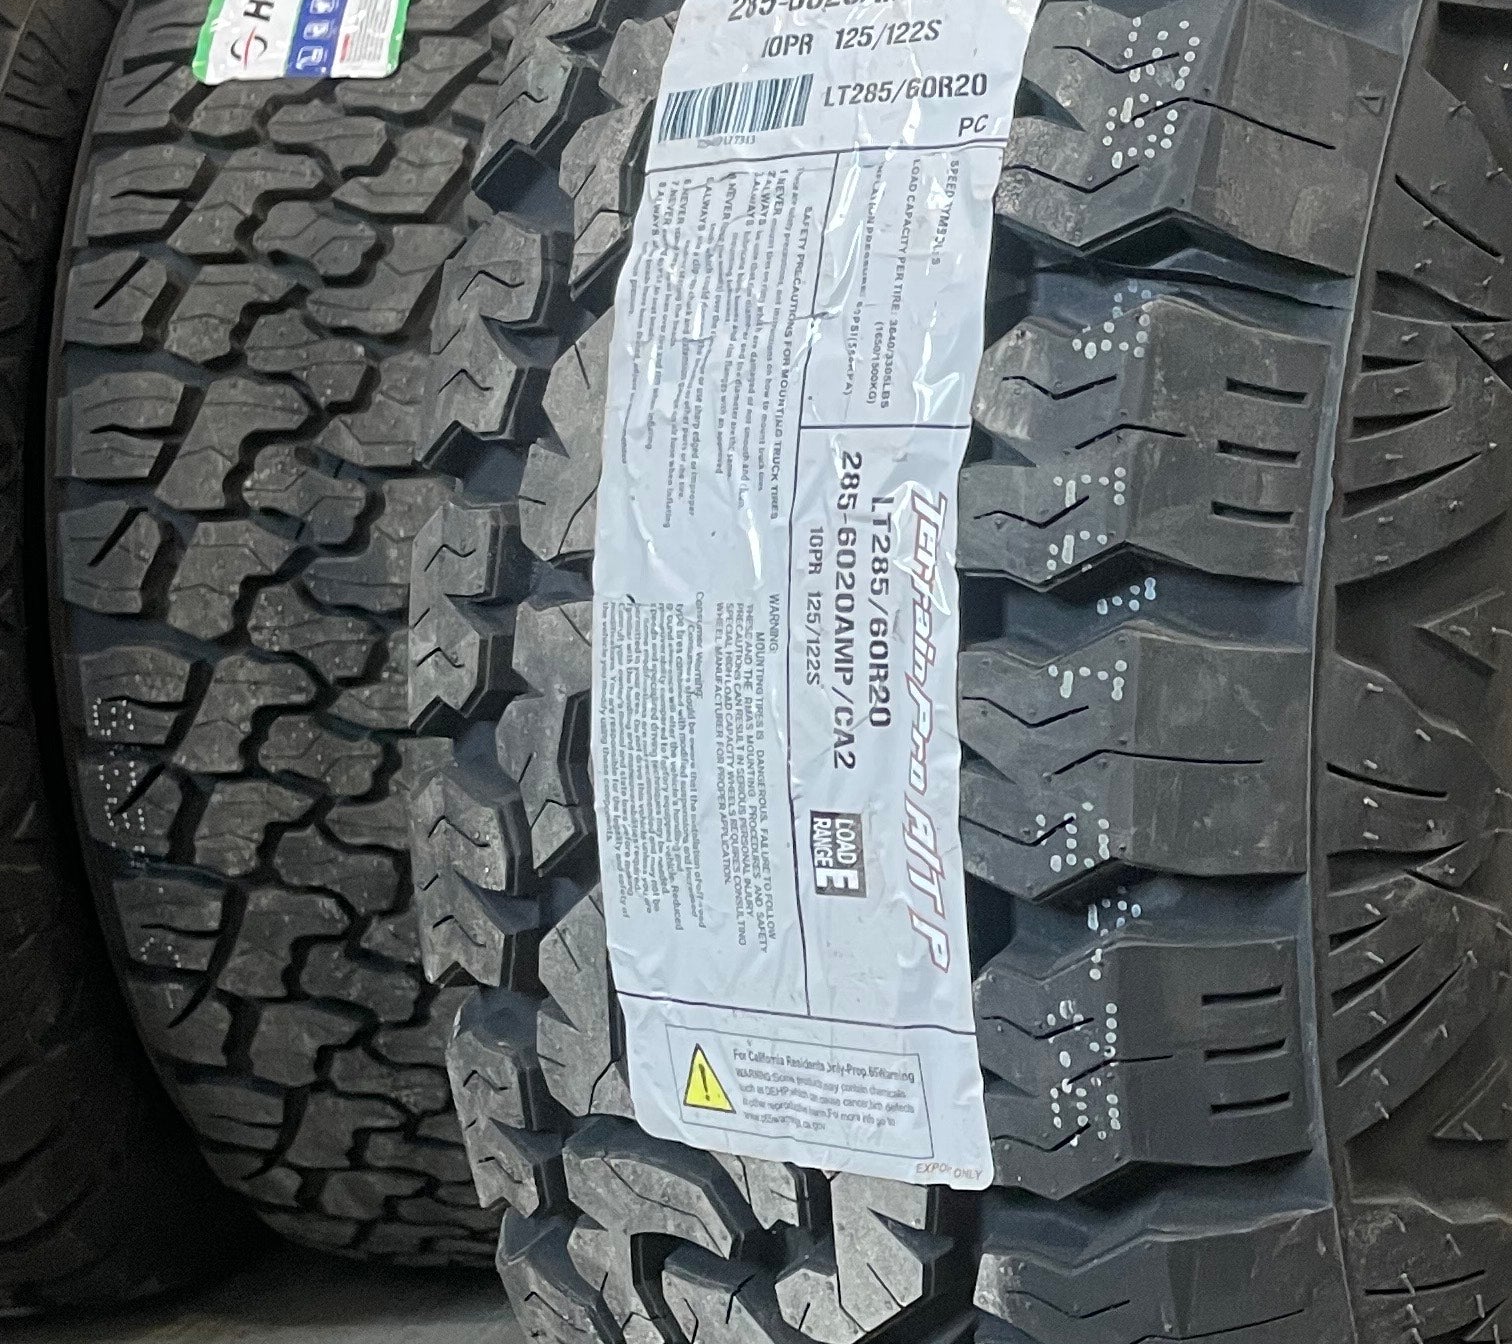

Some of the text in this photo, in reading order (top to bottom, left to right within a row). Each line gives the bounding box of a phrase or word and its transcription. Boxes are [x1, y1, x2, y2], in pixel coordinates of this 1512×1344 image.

[835, 18, 942, 51] 125/122S
[823, 72, 987, 108] LT285/60R20
[958, 114, 987, 138] PC
[773, 178, 786, 215] NEVER
[908, 159, 921, 192] LOAD
[663, 189, 678, 225] NEVER
[677, 189, 689, 224] NEVER
[697, 186, 712, 231] ALWAYS
[722, 183, 736, 222] NEVER
[745, 180, 761, 226] ALWAYS
[758, 179, 772, 225] ALWAYS
[898, 195, 916, 253] CAPACITY
[894, 257, 906, 281] PER
[770, 207, 813, 519] SAFETY PRECAUTIONS FOR MOUNTING TRUCK TIRES
[715, 603, 724, 644] WHEEL
[724, 603, 734, 648] SPECIAL
[805, 526, 824, 686] 10PR 125/122S
[832, 450, 863, 770] 285-6020AMP/CA2
[868, 496, 896, 728] LT285/60R20
[744, 642, 753, 665] AND
[755, 632, 765, 695] MOUNTING
[714, 646, 724, 738] MANUFACTURER
[724, 680, 733, 710] LOAD
[744, 669, 753, 690] THE
[755, 697, 764, 728] TIRES
[716, 742, 725, 764] FOR
[725, 713, 735, 768] CAPACITY
[755, 731, 765, 740] IS
[733, 603, 754, 917] PRECAUTIONS CAN RESULT IN SERIOUS PERSONAL INJURY
[747, 735, 756, 797] MOUNTING
[716, 767, 725, 810] PROPER
[726, 771, 736, 816] WHEELS
[730, 819, 741, 873] REQUIRES
[748, 806, 761, 879] PROCEDURES
[760, 828, 770, 874] FAILURE
[812, 817, 834, 868] RANGE
[835, 818, 857, 864] LOAD
[754, 885, 763, 907] AND
[763, 876, 772, 891] TO
[815, 868, 859, 889] E
[733, 876, 747, 946] CONSULTING
[756, 912, 767, 953] SAFETY
[765, 894, 776, 939] FOLLOW
